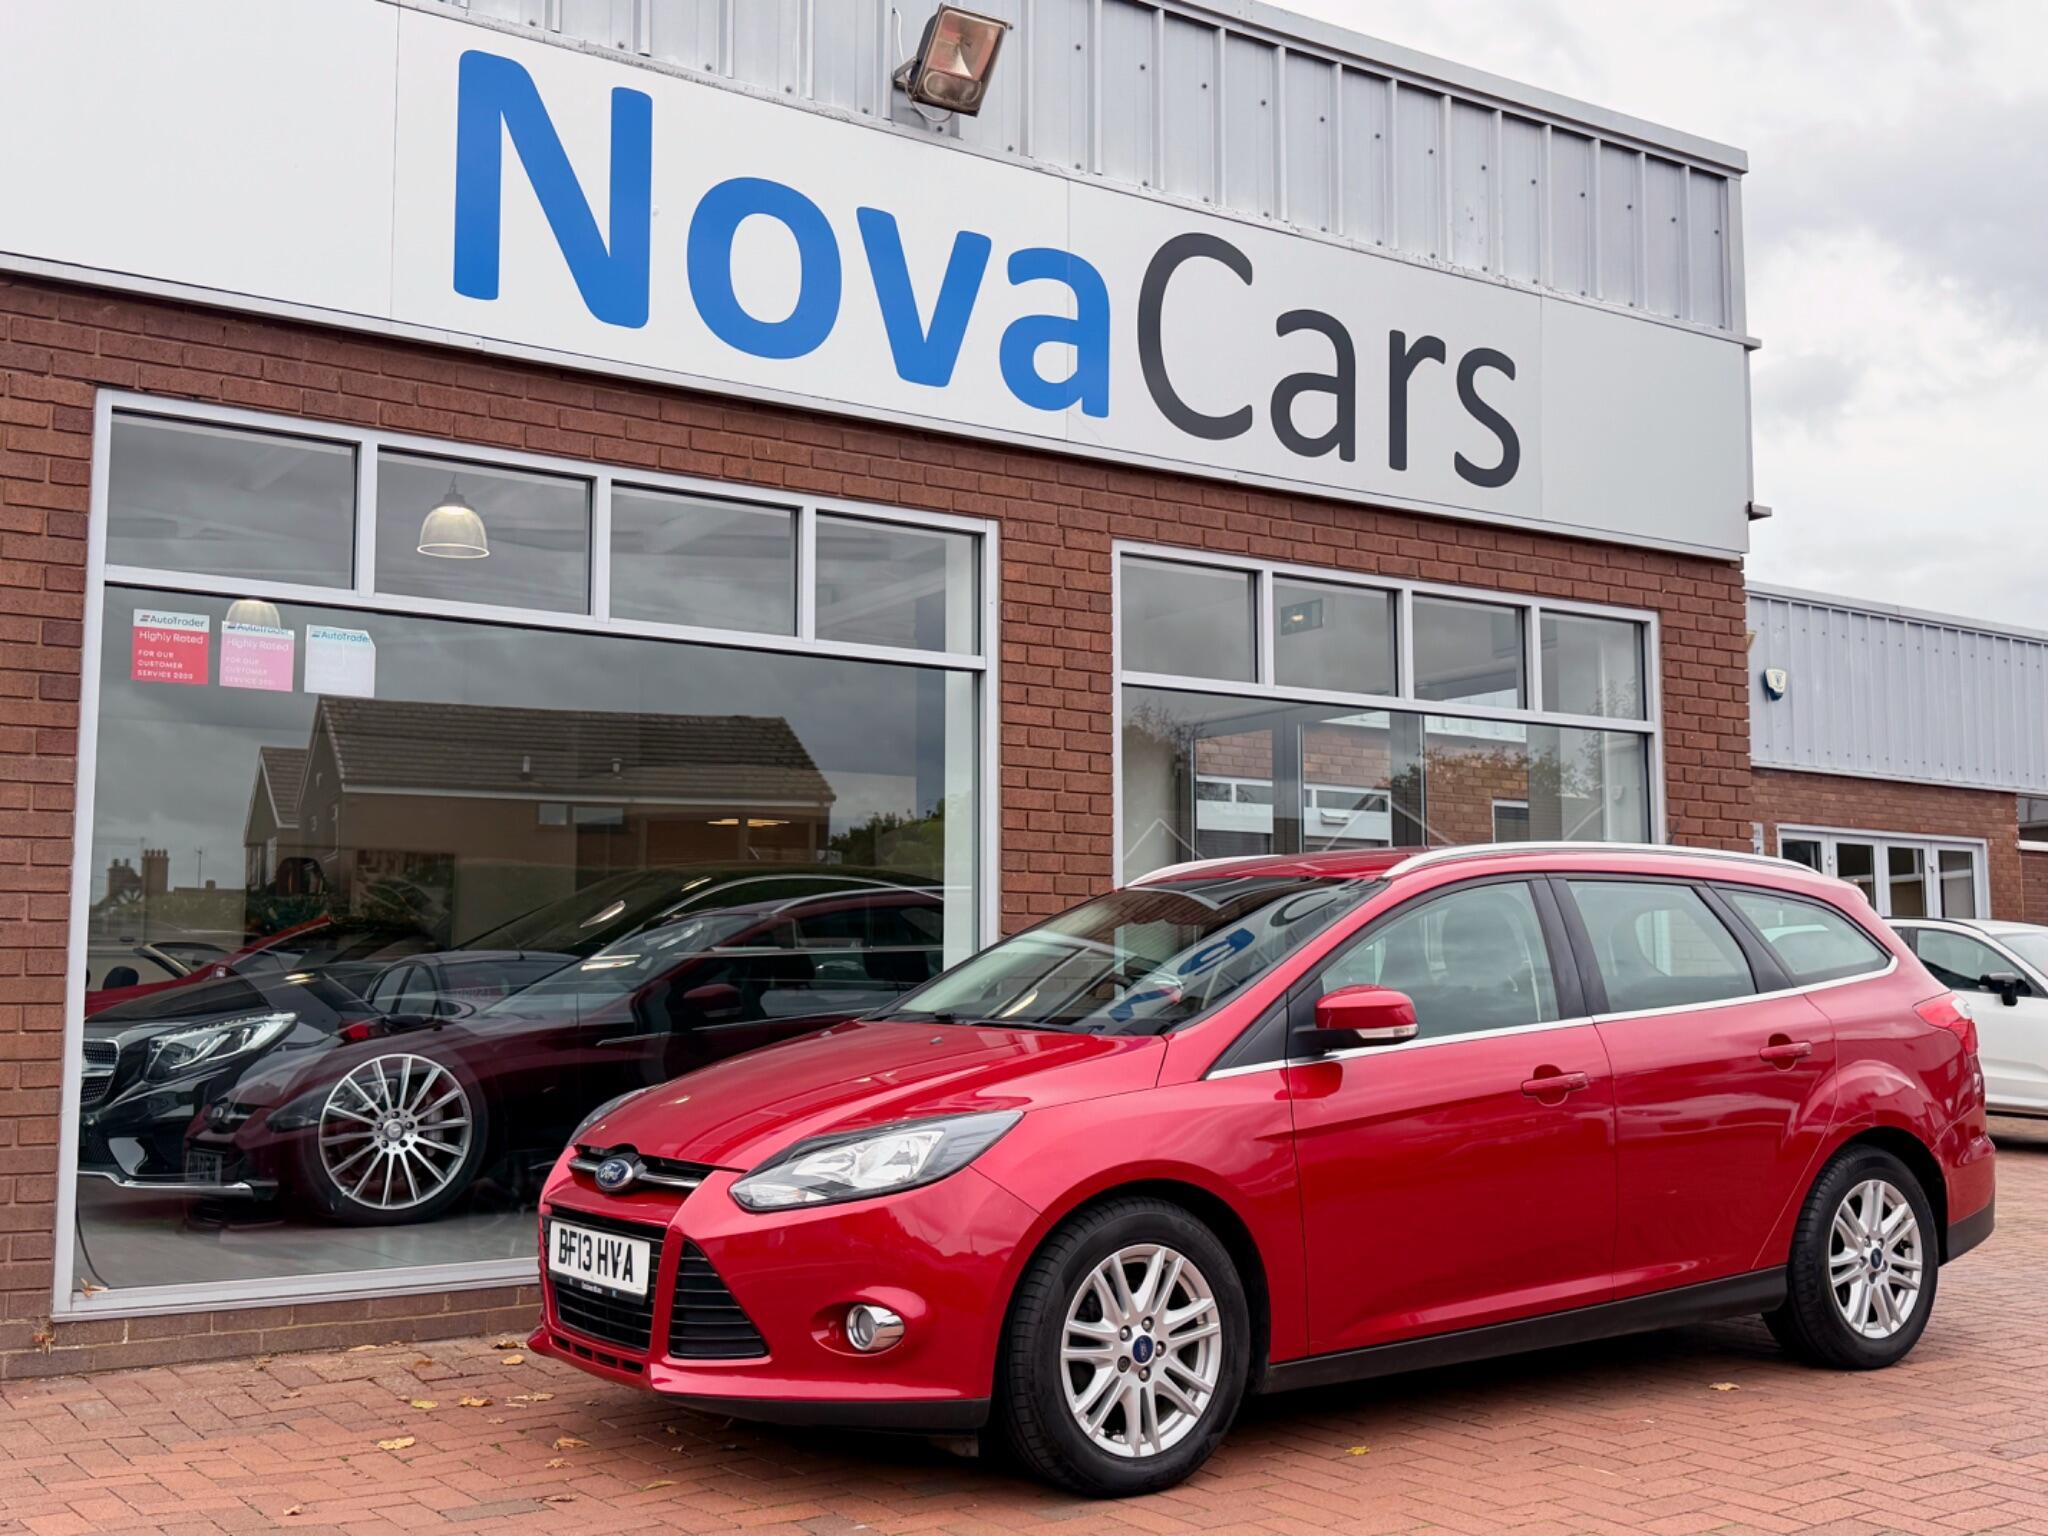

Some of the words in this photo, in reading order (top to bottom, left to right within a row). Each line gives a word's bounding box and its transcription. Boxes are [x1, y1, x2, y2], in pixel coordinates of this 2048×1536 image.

[454, 50, 1522, 490] NovaCars
[150, 614, 206, 628] AutoTrader
[139, 631, 171, 644] Highly
[173, 633, 204, 645] Rated
[227, 637, 258, 650] Highly
[259, 640, 289, 652] Rated
[138, 649, 155, 658] FOR
[156, 651, 174, 659] OUR
[137, 659, 183, 669] CUSTOMER
[136, 669, 171, 679] SERVICE
[558, 1227, 593, 1272] BF13
[597, 1237, 634, 1283] HVA
